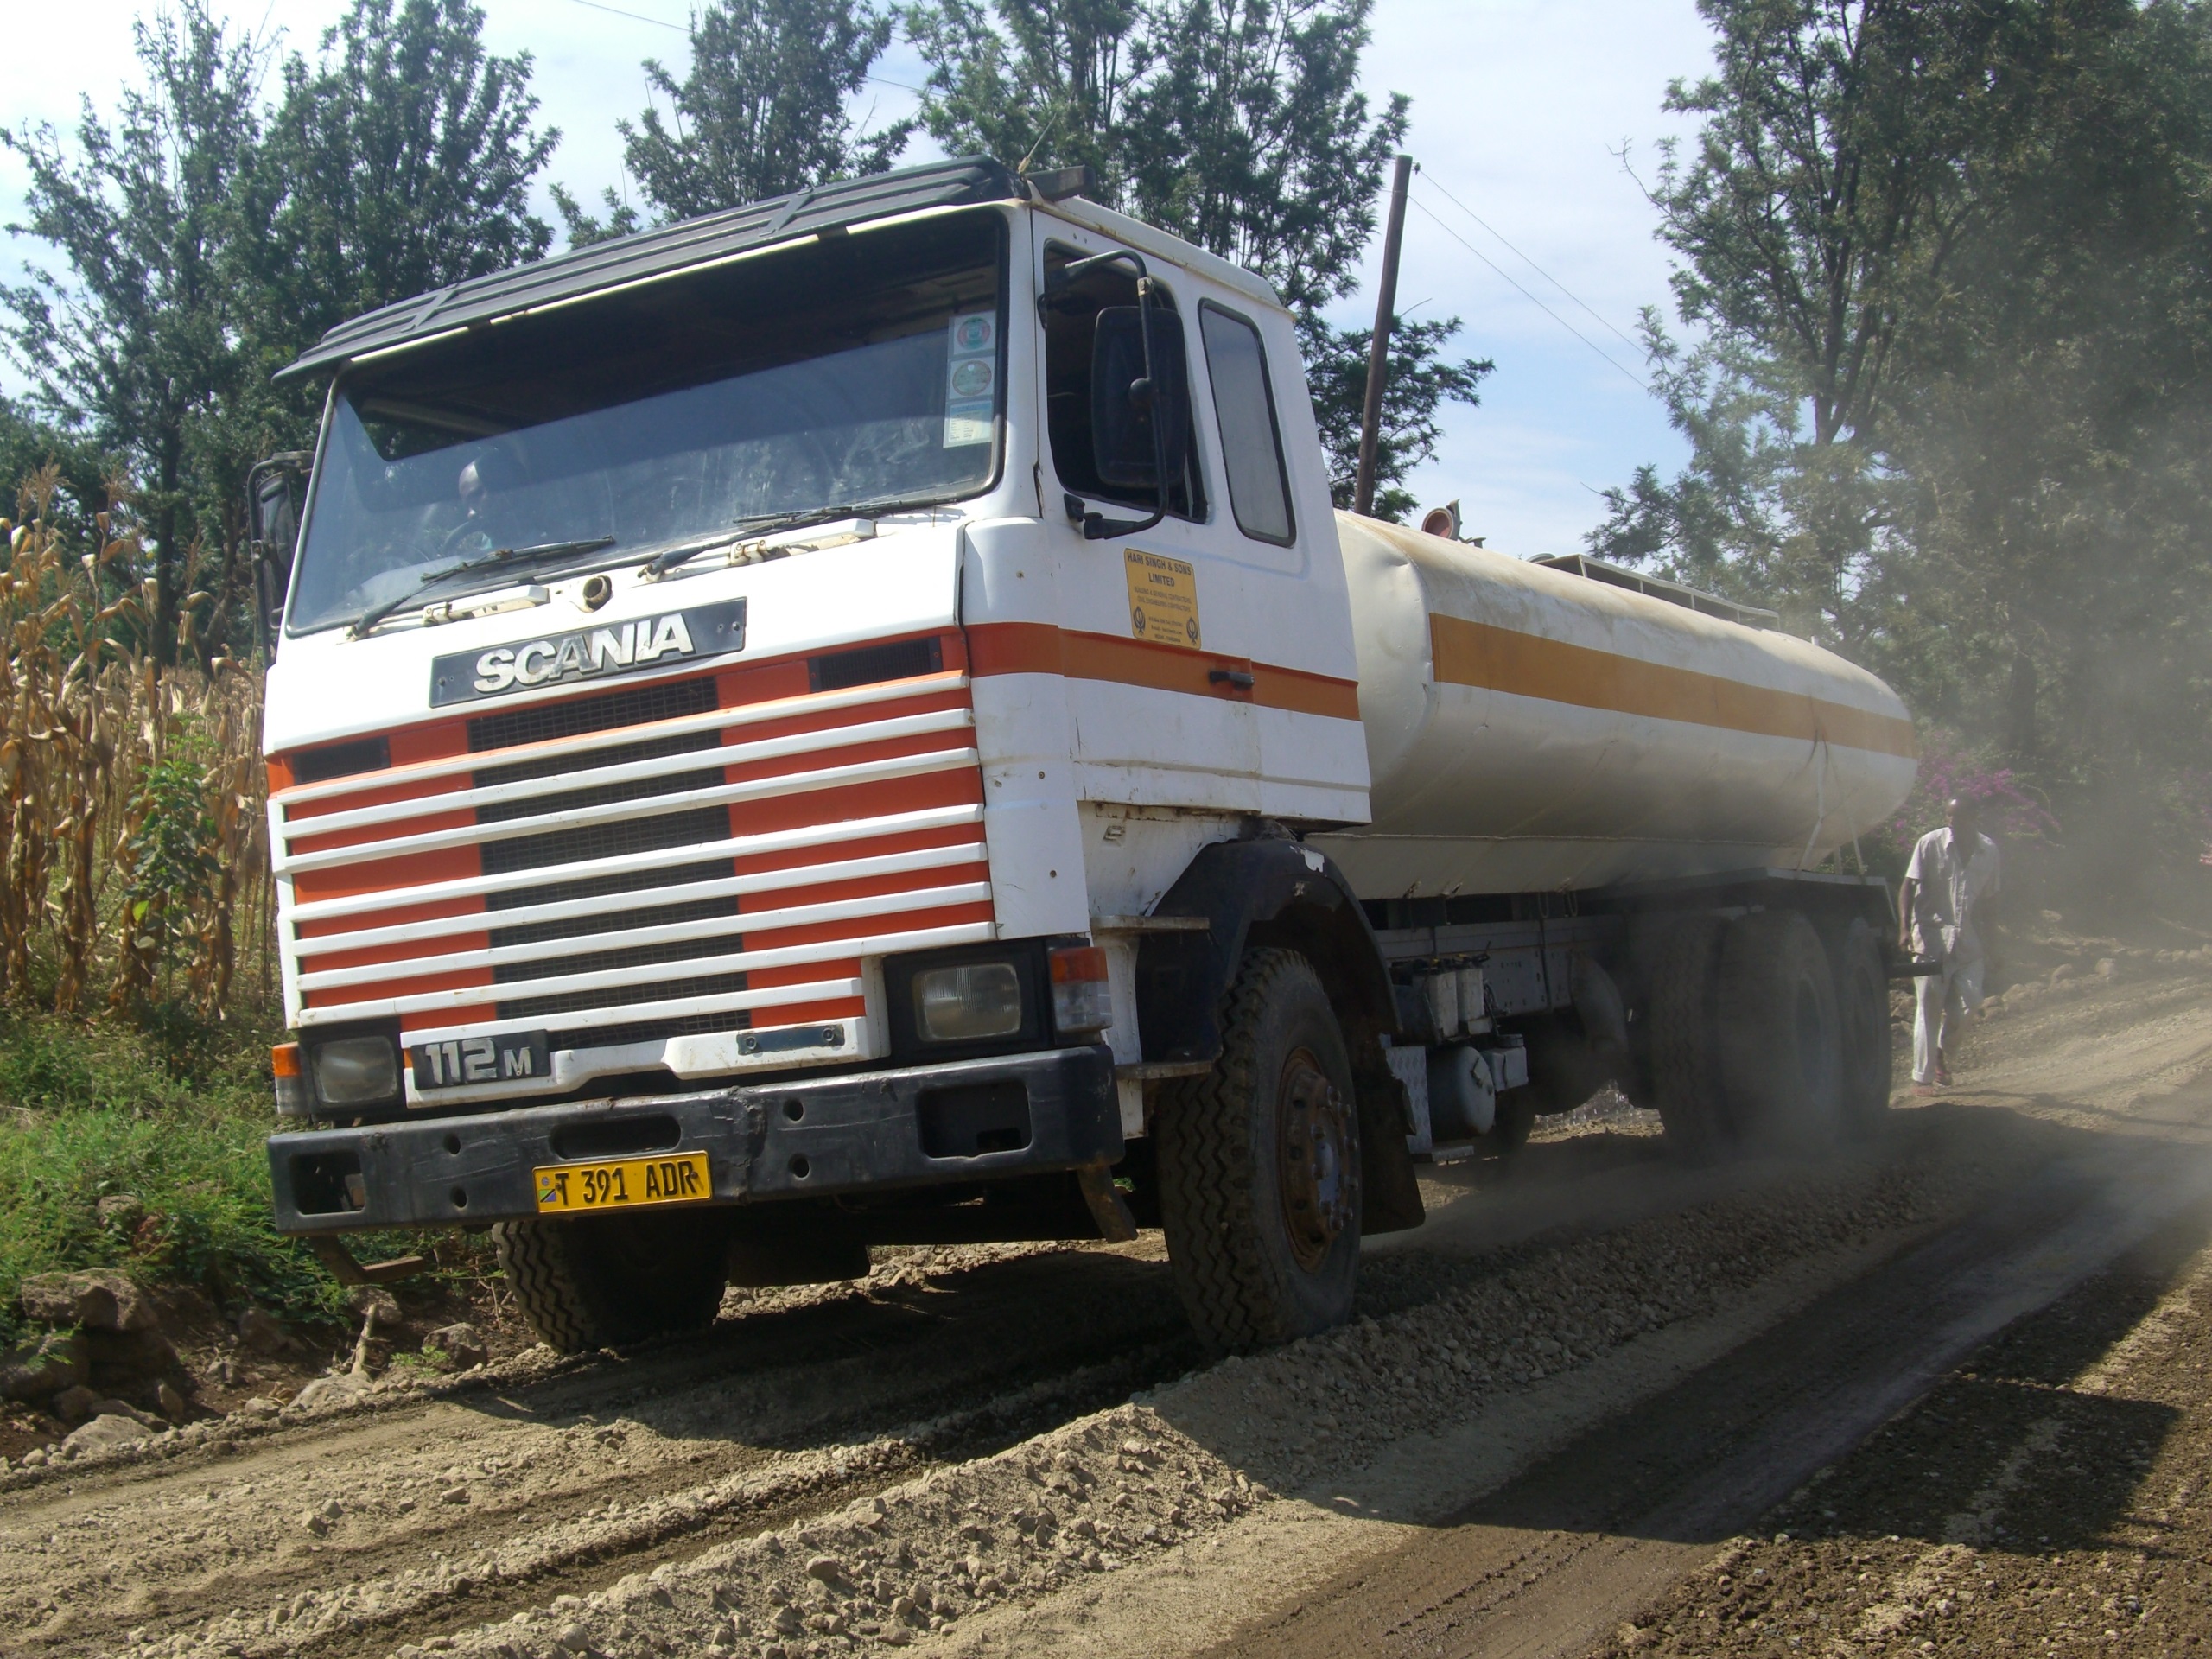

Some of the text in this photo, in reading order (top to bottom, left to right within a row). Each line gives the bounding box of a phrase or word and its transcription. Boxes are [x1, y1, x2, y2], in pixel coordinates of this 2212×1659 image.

[1128, 552, 1192, 575] HARI SINGH & SONS
[1148, 573, 1175, 587] LIMITED
[473, 612, 696, 693] SCANIA
[424, 1037, 532, 1086] 112 M
[554, 1160, 697, 1206] T 391 ADR
